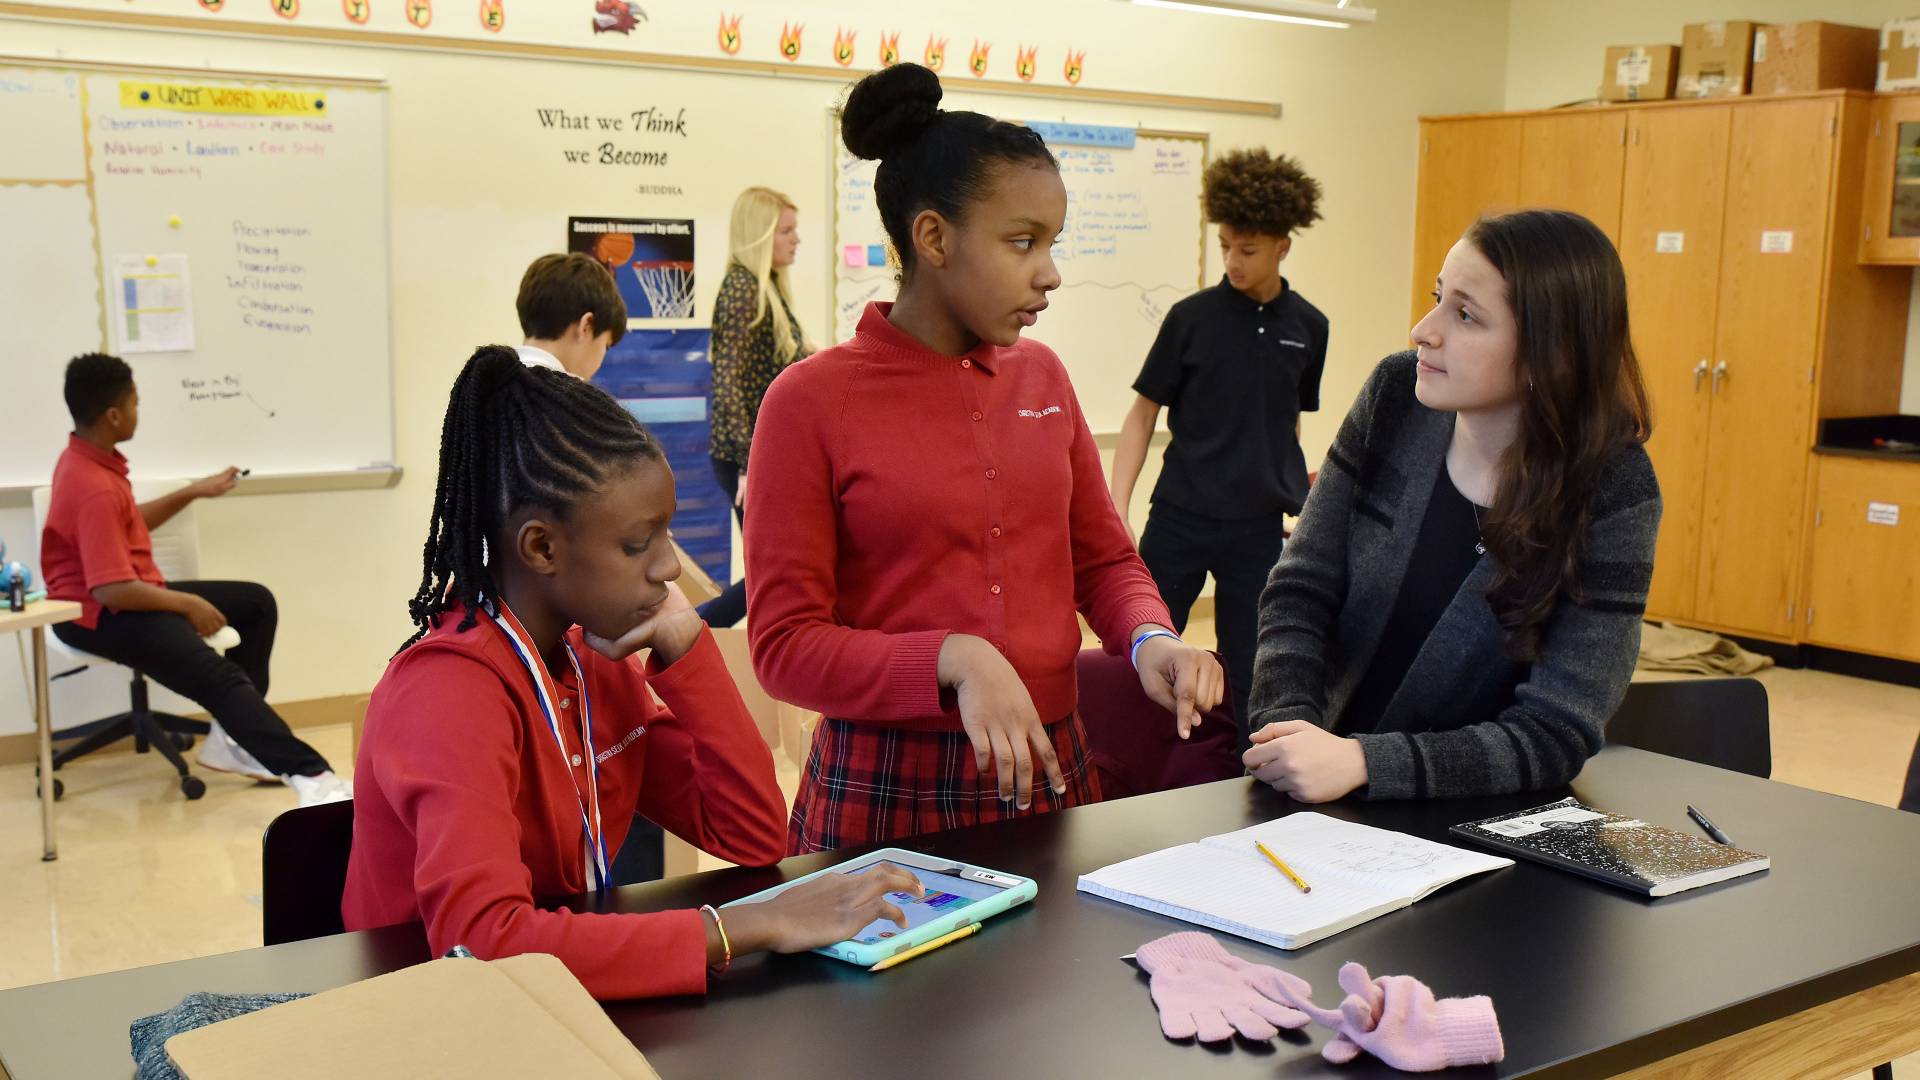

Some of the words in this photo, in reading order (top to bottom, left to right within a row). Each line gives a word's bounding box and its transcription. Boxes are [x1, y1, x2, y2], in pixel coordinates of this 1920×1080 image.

[157, 85, 202, 105] UNIT
[208, 88, 255, 109] WORD
[262, 91, 309, 111] WALL
[536, 107, 589, 129] What
[596, 117, 623, 131] we
[631, 106, 686, 137] Think
[564, 150, 590, 163] we
[598, 142, 668, 166] Become
[574, 221, 607, 233] Success
[616, 223, 655, 234] measured
[656, 223, 666, 235] by
